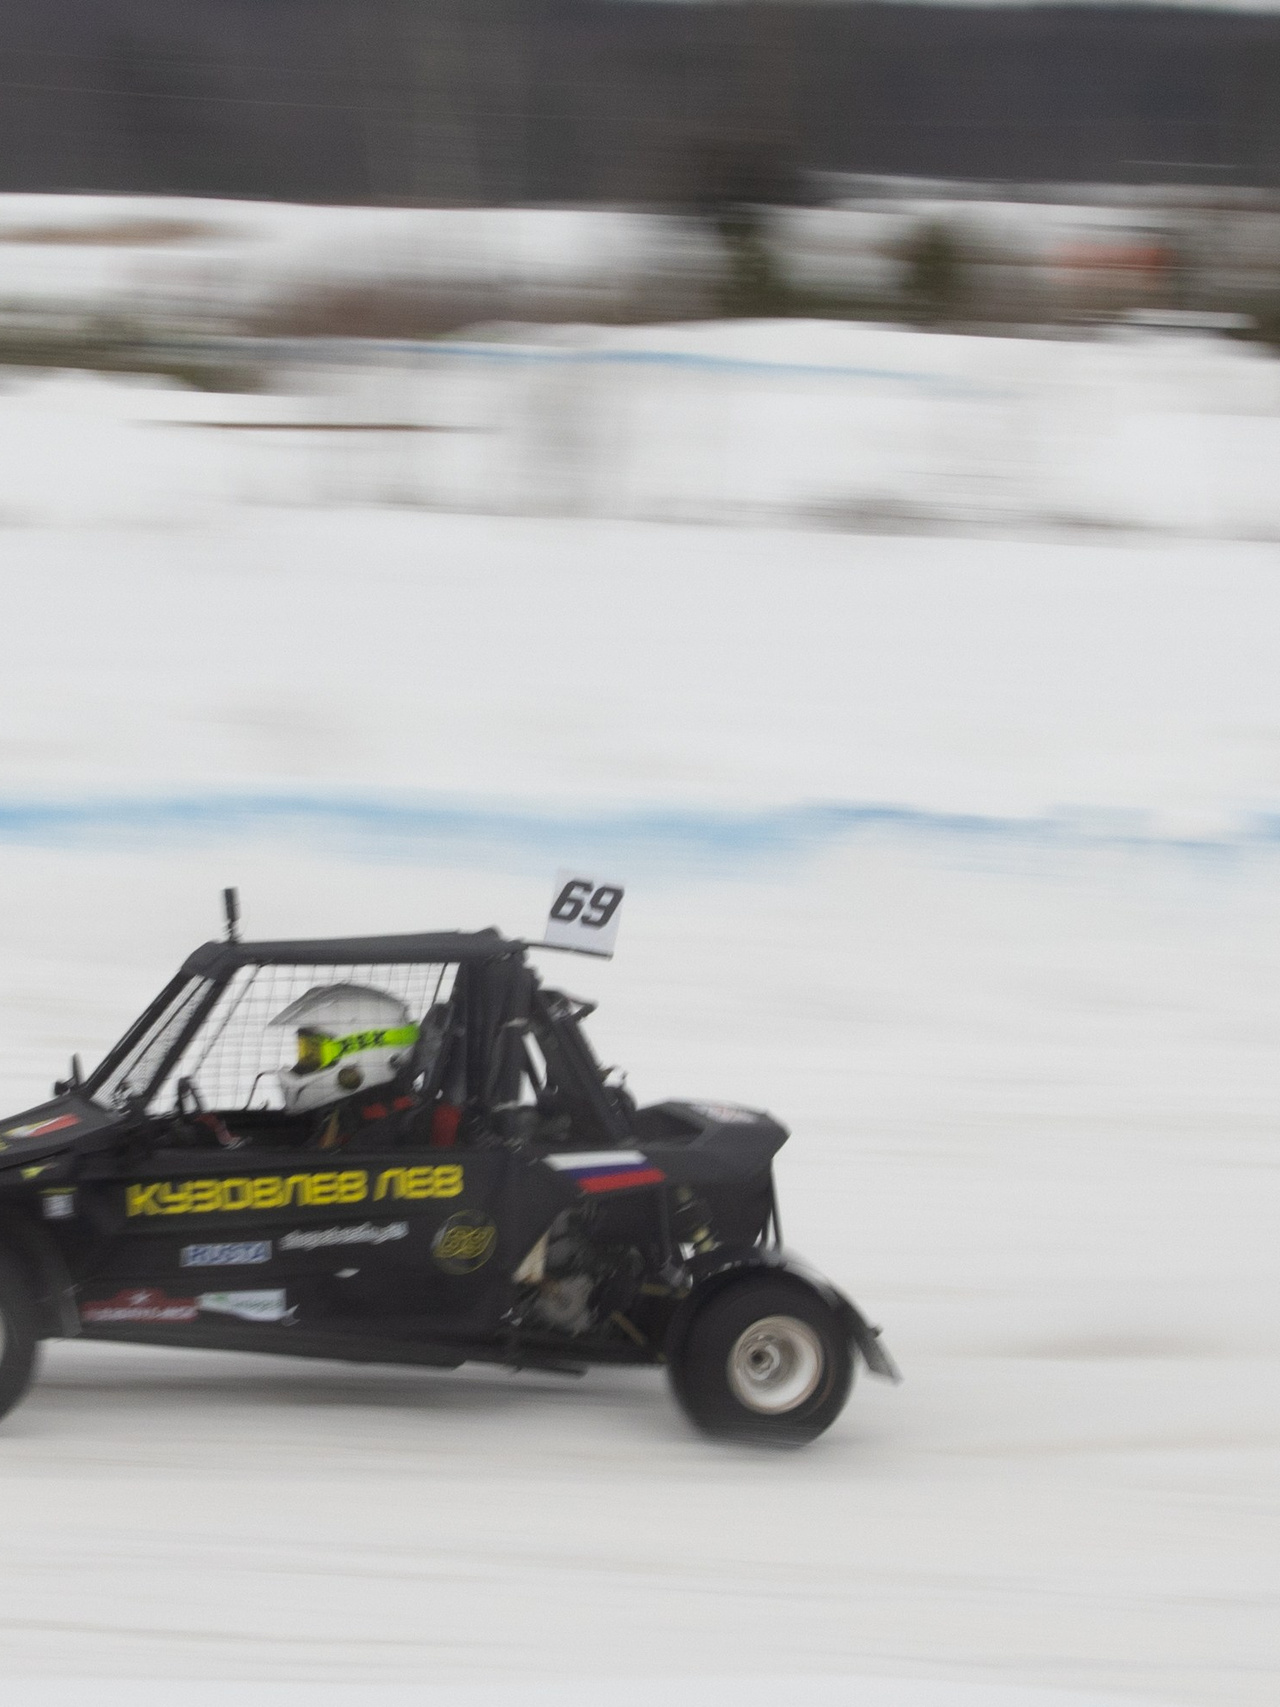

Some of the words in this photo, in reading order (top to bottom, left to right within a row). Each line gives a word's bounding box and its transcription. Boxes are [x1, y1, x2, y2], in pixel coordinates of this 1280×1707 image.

[550, 879, 625, 929] 69
[125, 1170, 369, 1217] КУЗОВЛЕВ
[373, 1164, 465, 1201] ЛЕВ
